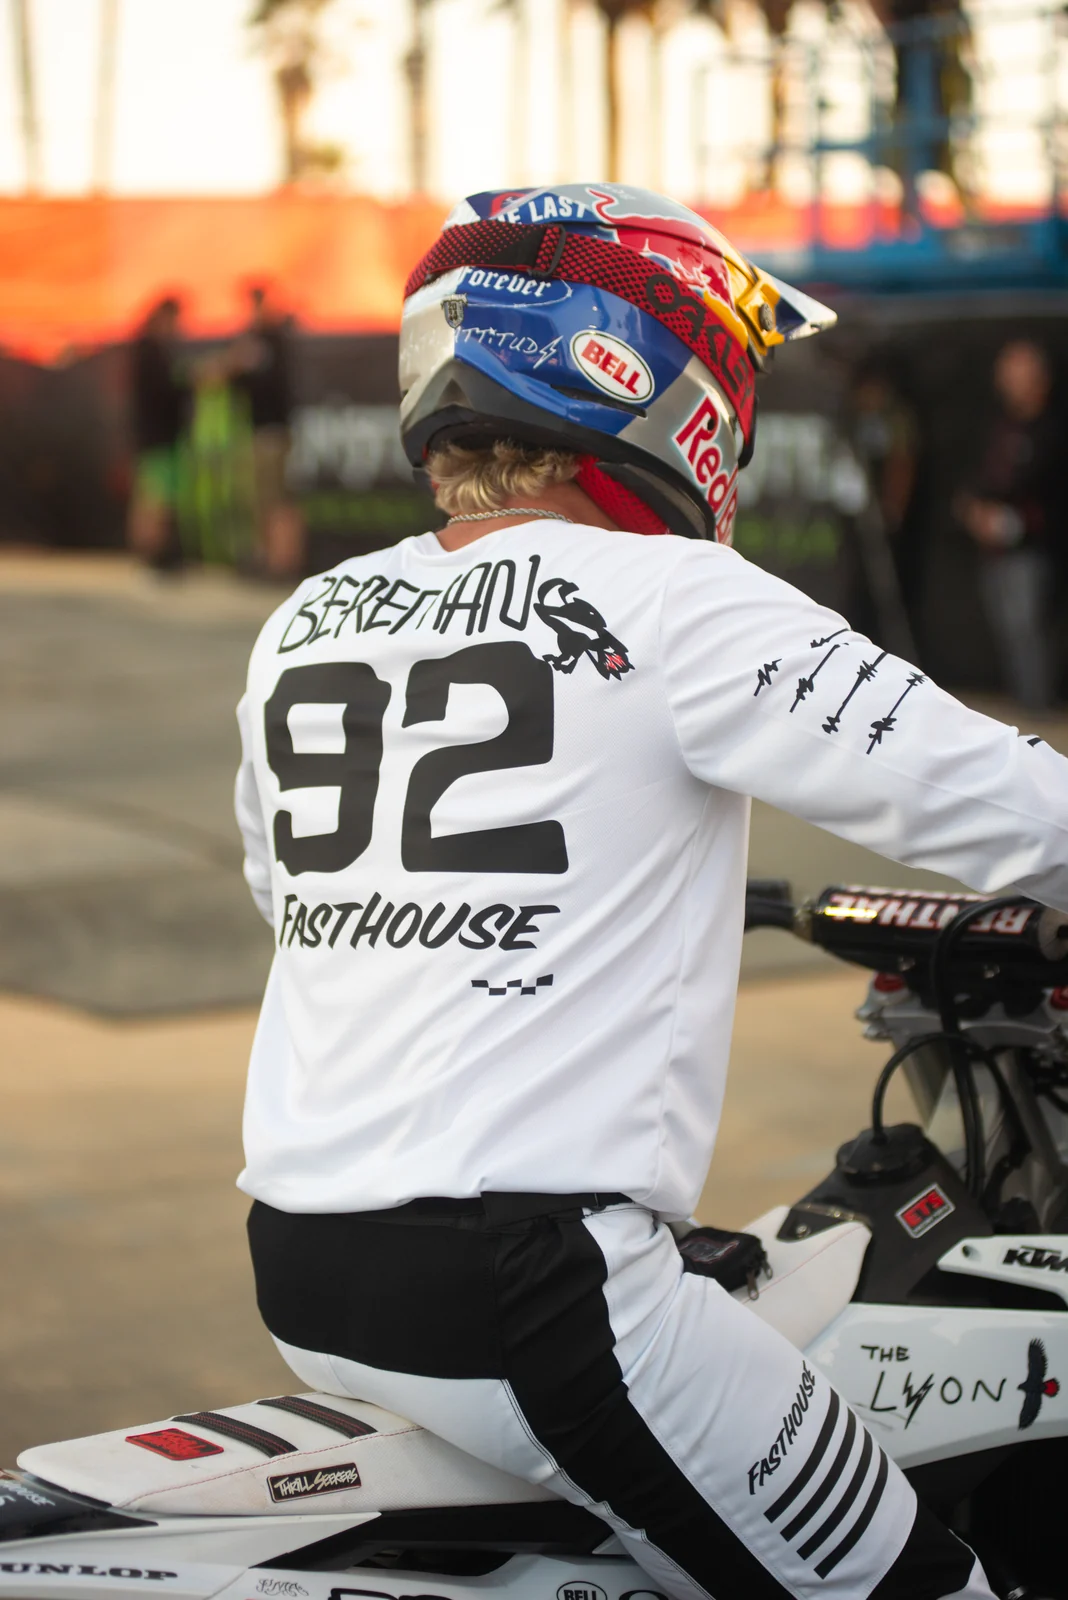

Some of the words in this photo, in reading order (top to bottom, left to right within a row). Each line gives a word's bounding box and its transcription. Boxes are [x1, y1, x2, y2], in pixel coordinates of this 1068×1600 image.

[528, 196, 587, 222] LAST
[581, 338, 641, 395] BELL
[264, 640, 570, 877] 92
[279, 892, 561, 951] FASTHOUSE
[861, 1344, 910, 1362] THE
[747, 1360, 816, 1496] FASTHOUSE
[273, 1476, 315, 1497] THRILL
[313, 1467, 359, 1491] SEEKERS
[0, 1563, 178, 1580] UNLOP
